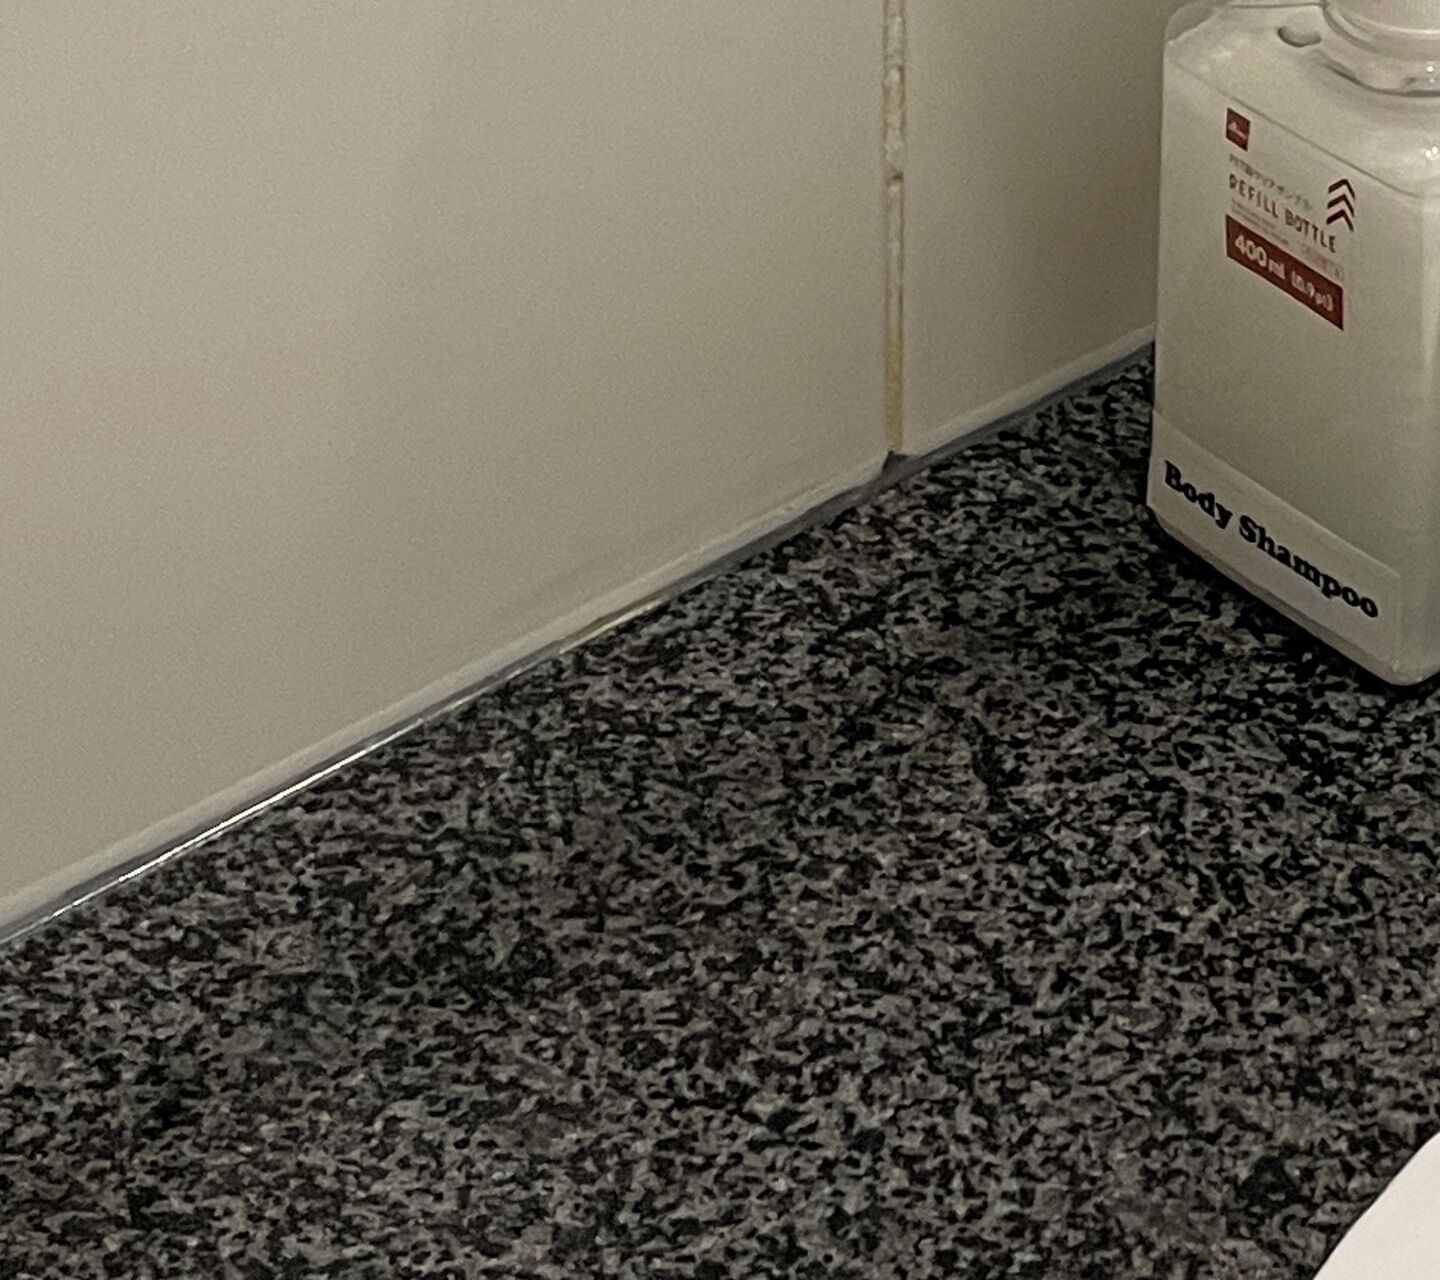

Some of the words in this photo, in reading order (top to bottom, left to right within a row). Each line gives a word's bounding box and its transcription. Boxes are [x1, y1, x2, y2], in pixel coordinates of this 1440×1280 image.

[1228, 173, 1279, 219] REFILL
[1285, 208, 1336, 253] BOTTLE
[1164, 459, 1233, 529] Body
[1239, 515, 1379, 618] Shampoo
